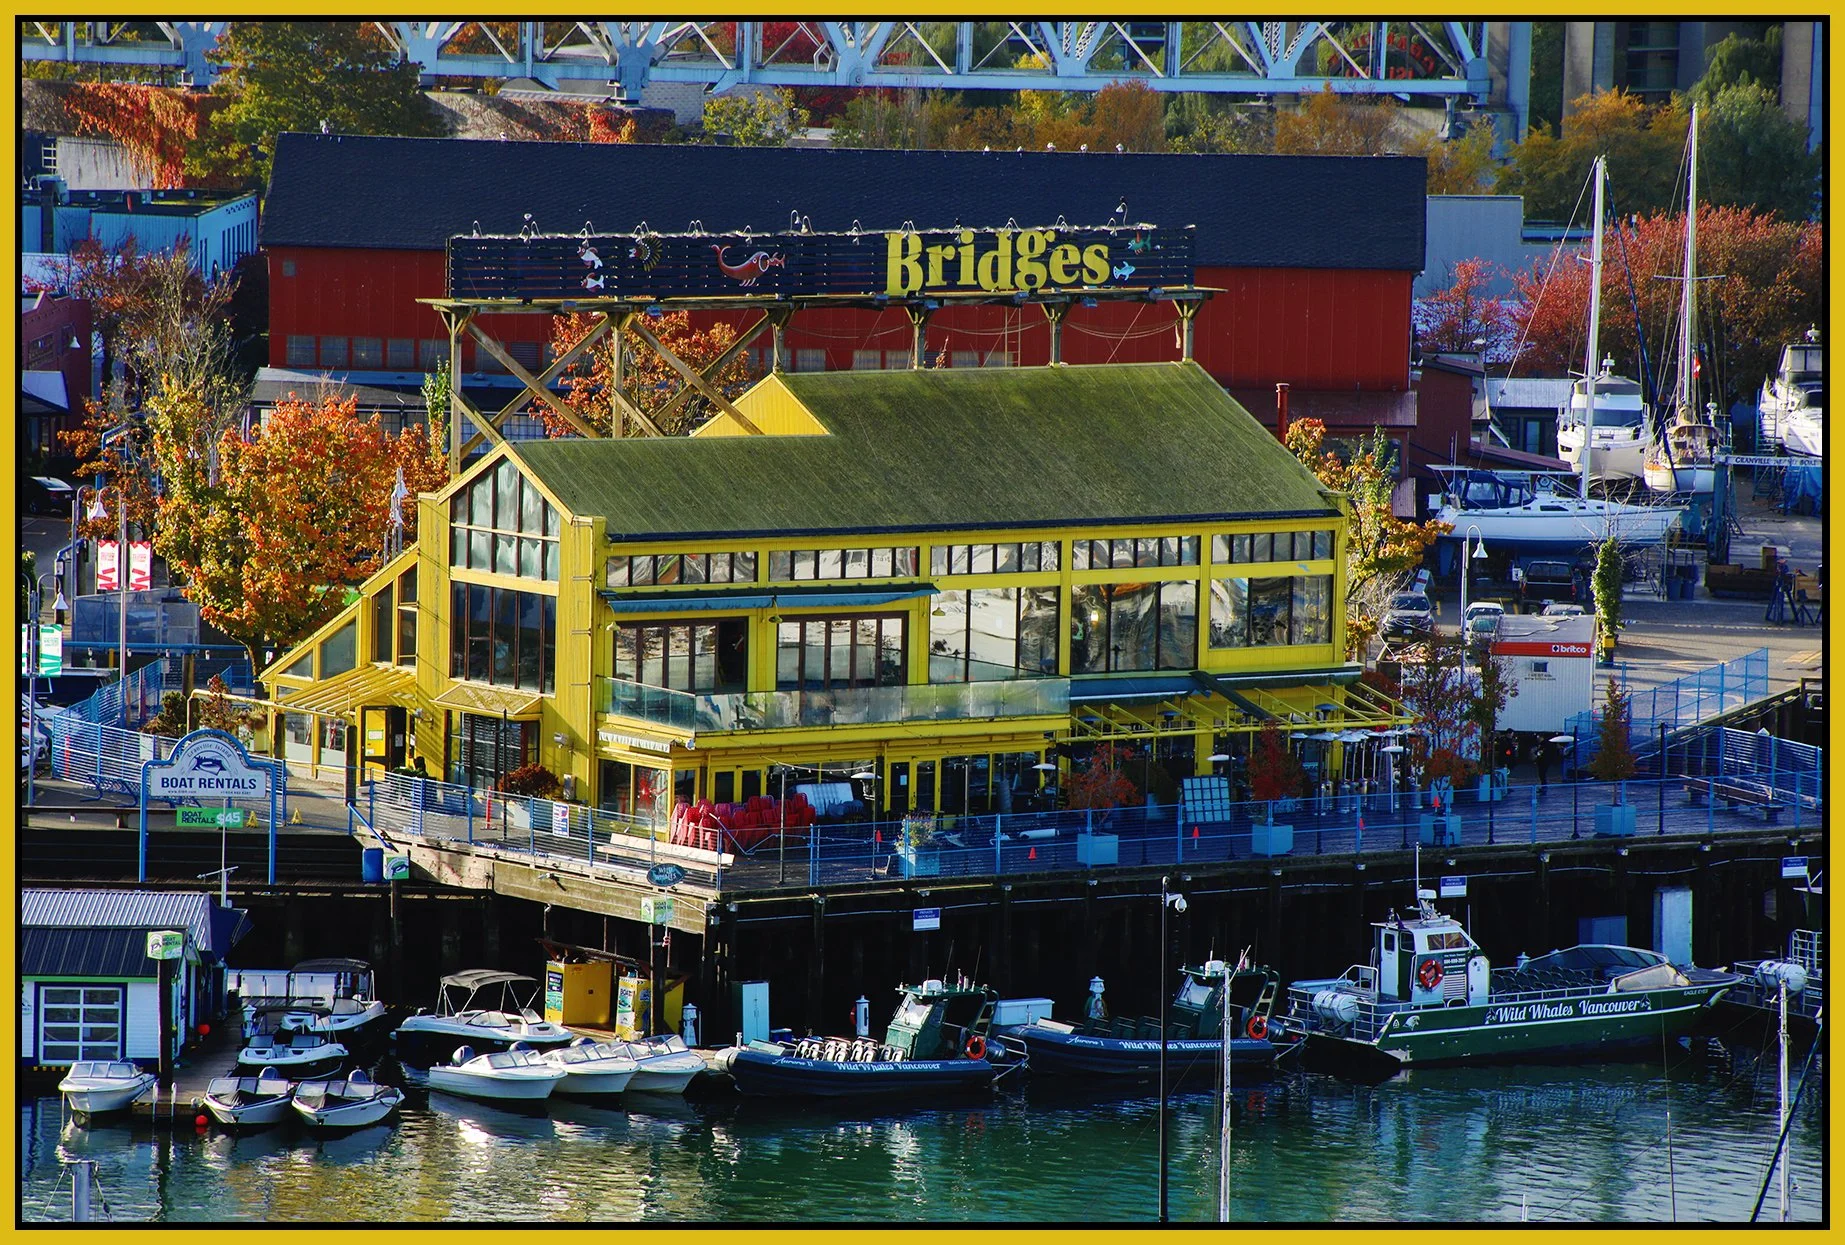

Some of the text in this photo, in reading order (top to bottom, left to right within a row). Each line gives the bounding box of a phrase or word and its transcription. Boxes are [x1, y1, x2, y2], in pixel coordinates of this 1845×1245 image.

[884, 231, 1110, 295] Bridges
[1560, 645, 1587, 654] britco
[161, 777, 257, 790] BOAT RENTALS
[216, 811, 241, 826] $45
[1496, 999, 1641, 1023] Wild Whales Vancouver
[1118, 1041, 1144, 1050] Wild
[1177, 1041, 1222, 1049] Vancouver
[834, 1062, 860, 1071] Wild
[859, 1062, 894, 1072] Whales
[893, 1062, 941, 1071] Vancouver
